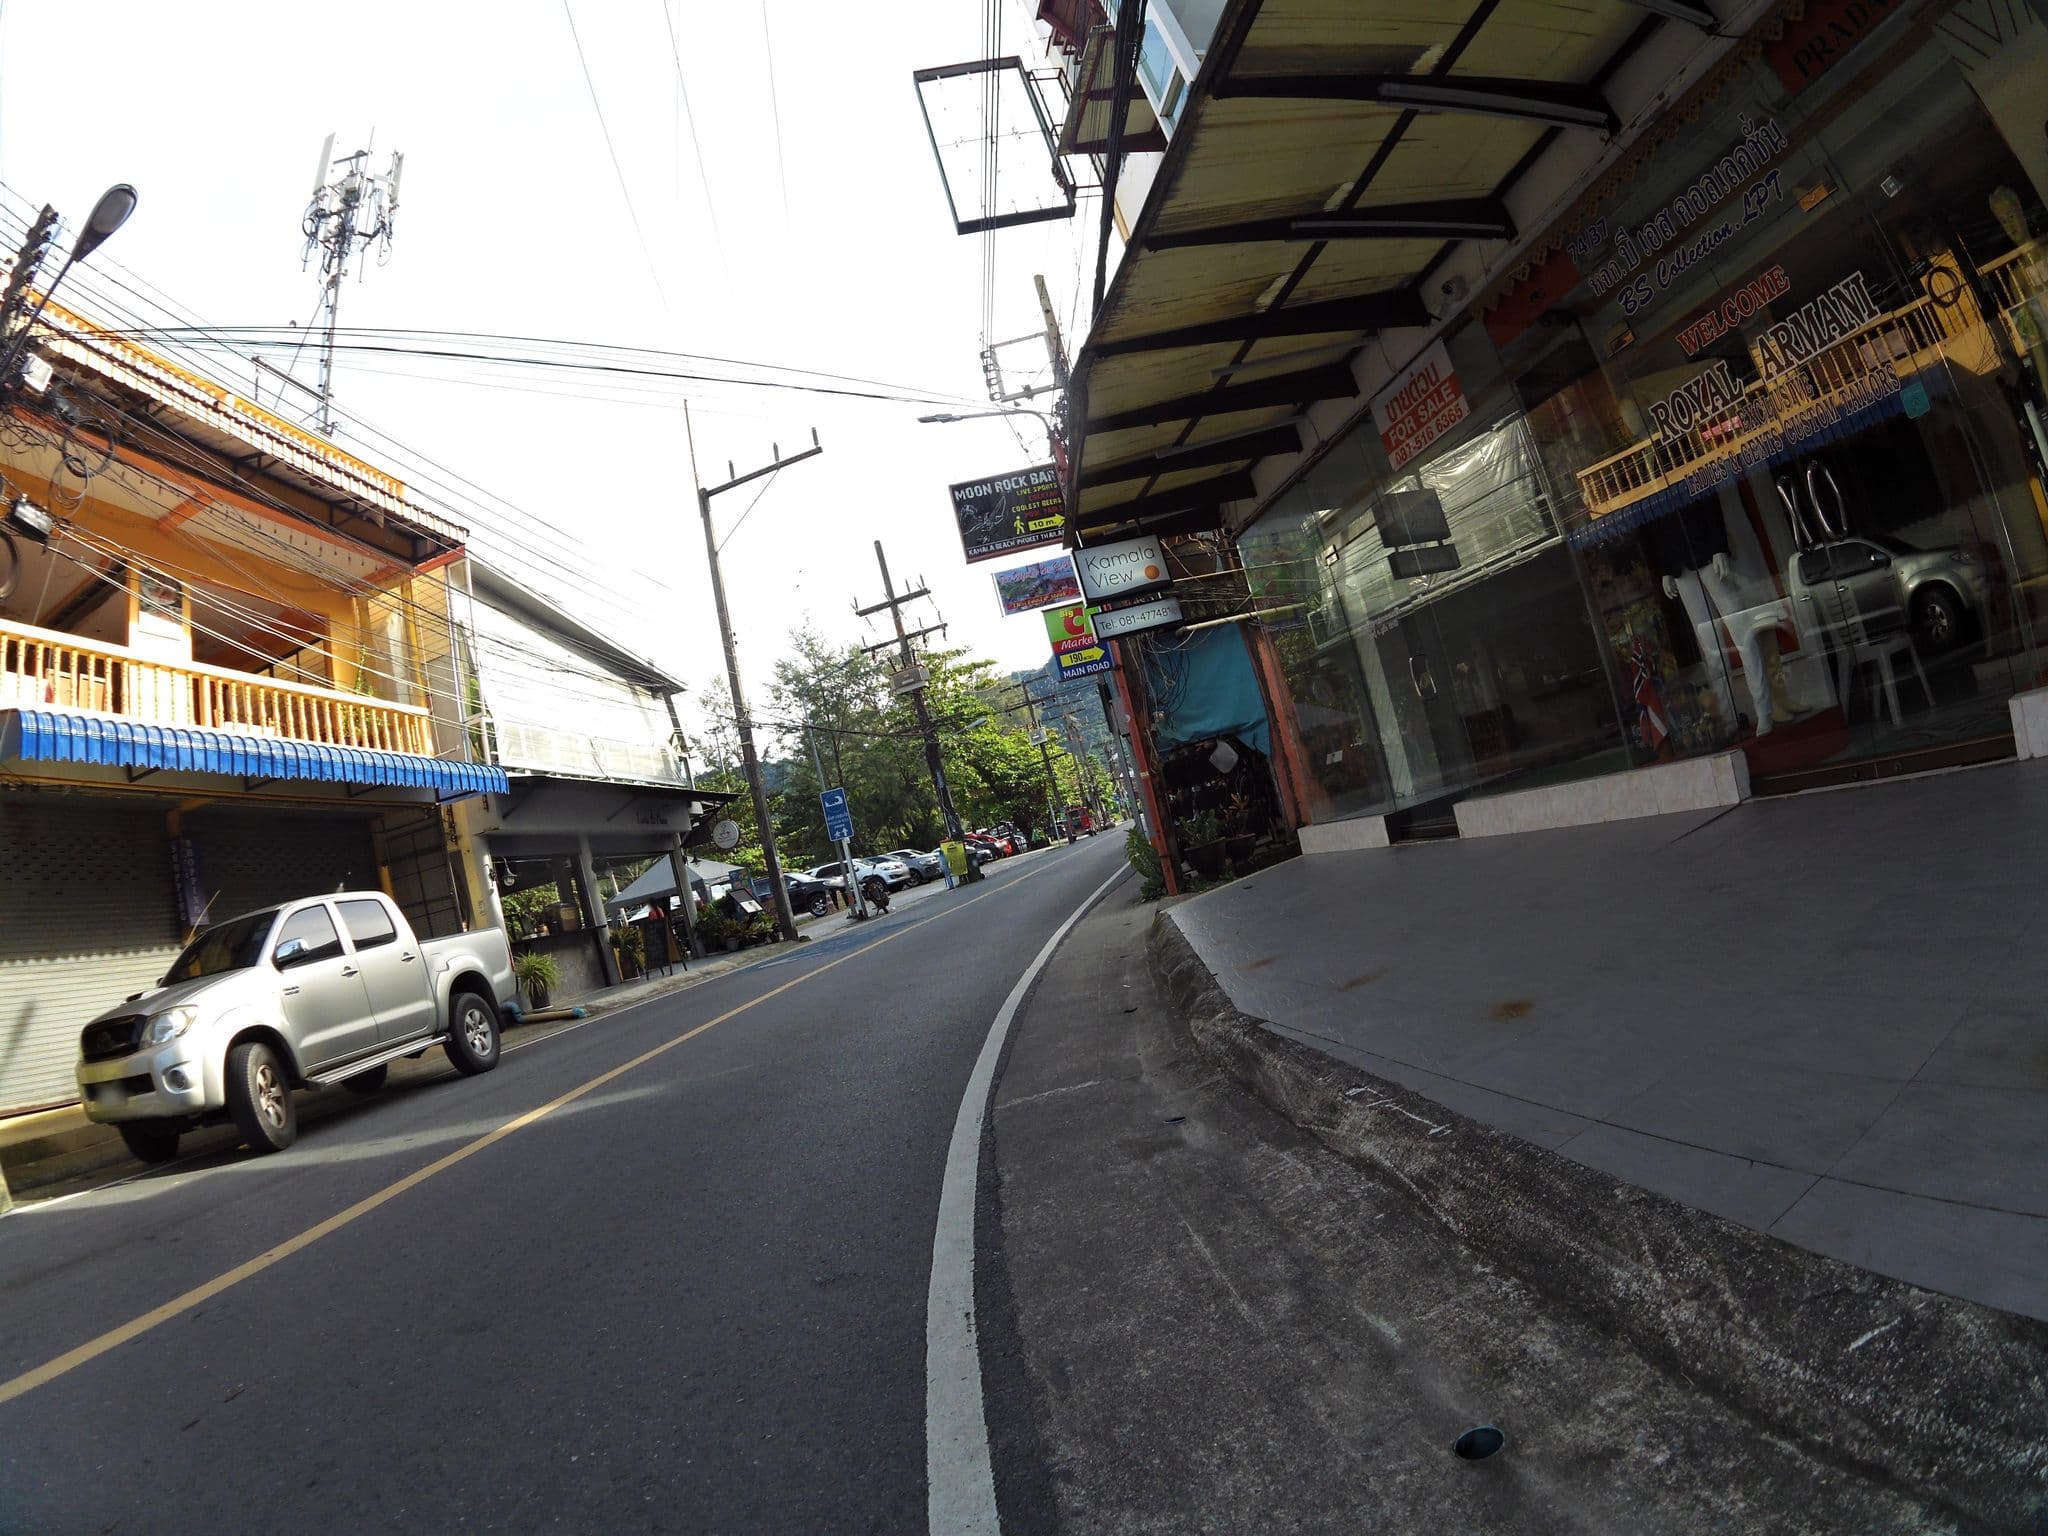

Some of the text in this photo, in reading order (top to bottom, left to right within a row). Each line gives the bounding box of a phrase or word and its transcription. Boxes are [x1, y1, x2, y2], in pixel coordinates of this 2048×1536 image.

[1793, 0, 1886, 78] PRAD
[1618, 273, 1654, 315] BS
[1675, 264, 1790, 357] WELCOME
[1648, 270, 1882, 446] ROYAL ARMANI
[1737, 371, 1814, 432] EXCLUSIVE
[1388, 382, 1455, 447] FOR SALE
[1684, 362, 1902, 496] LADIES & GENTS CUSTOM TAILORS
[954, 484, 993, 502] MOON
[994, 476, 1029, 493] ROCK
[1016, 487, 1032, 496] LIVE
[1032, 483, 1058, 493] SPORTS
[1012, 502, 1040, 513] COOLEST
[1034, 520, 1044, 528] 10
[968, 544, 995, 556] KAMALA
[995, 540, 1016, 550] BEACH
[1017, 535, 1040, 545] PHUKET
[1085, 546, 1155, 571] Kamala
[1090, 570, 1133, 588] View
[1060, 610, 1074, 618] Big
[1118, 607, 1170, 627] 081-47748
[1061, 636, 1096, 650] Marke
[1069, 653, 1083, 663] 190
[1063, 661, 1110, 679] MAIN ROAD
